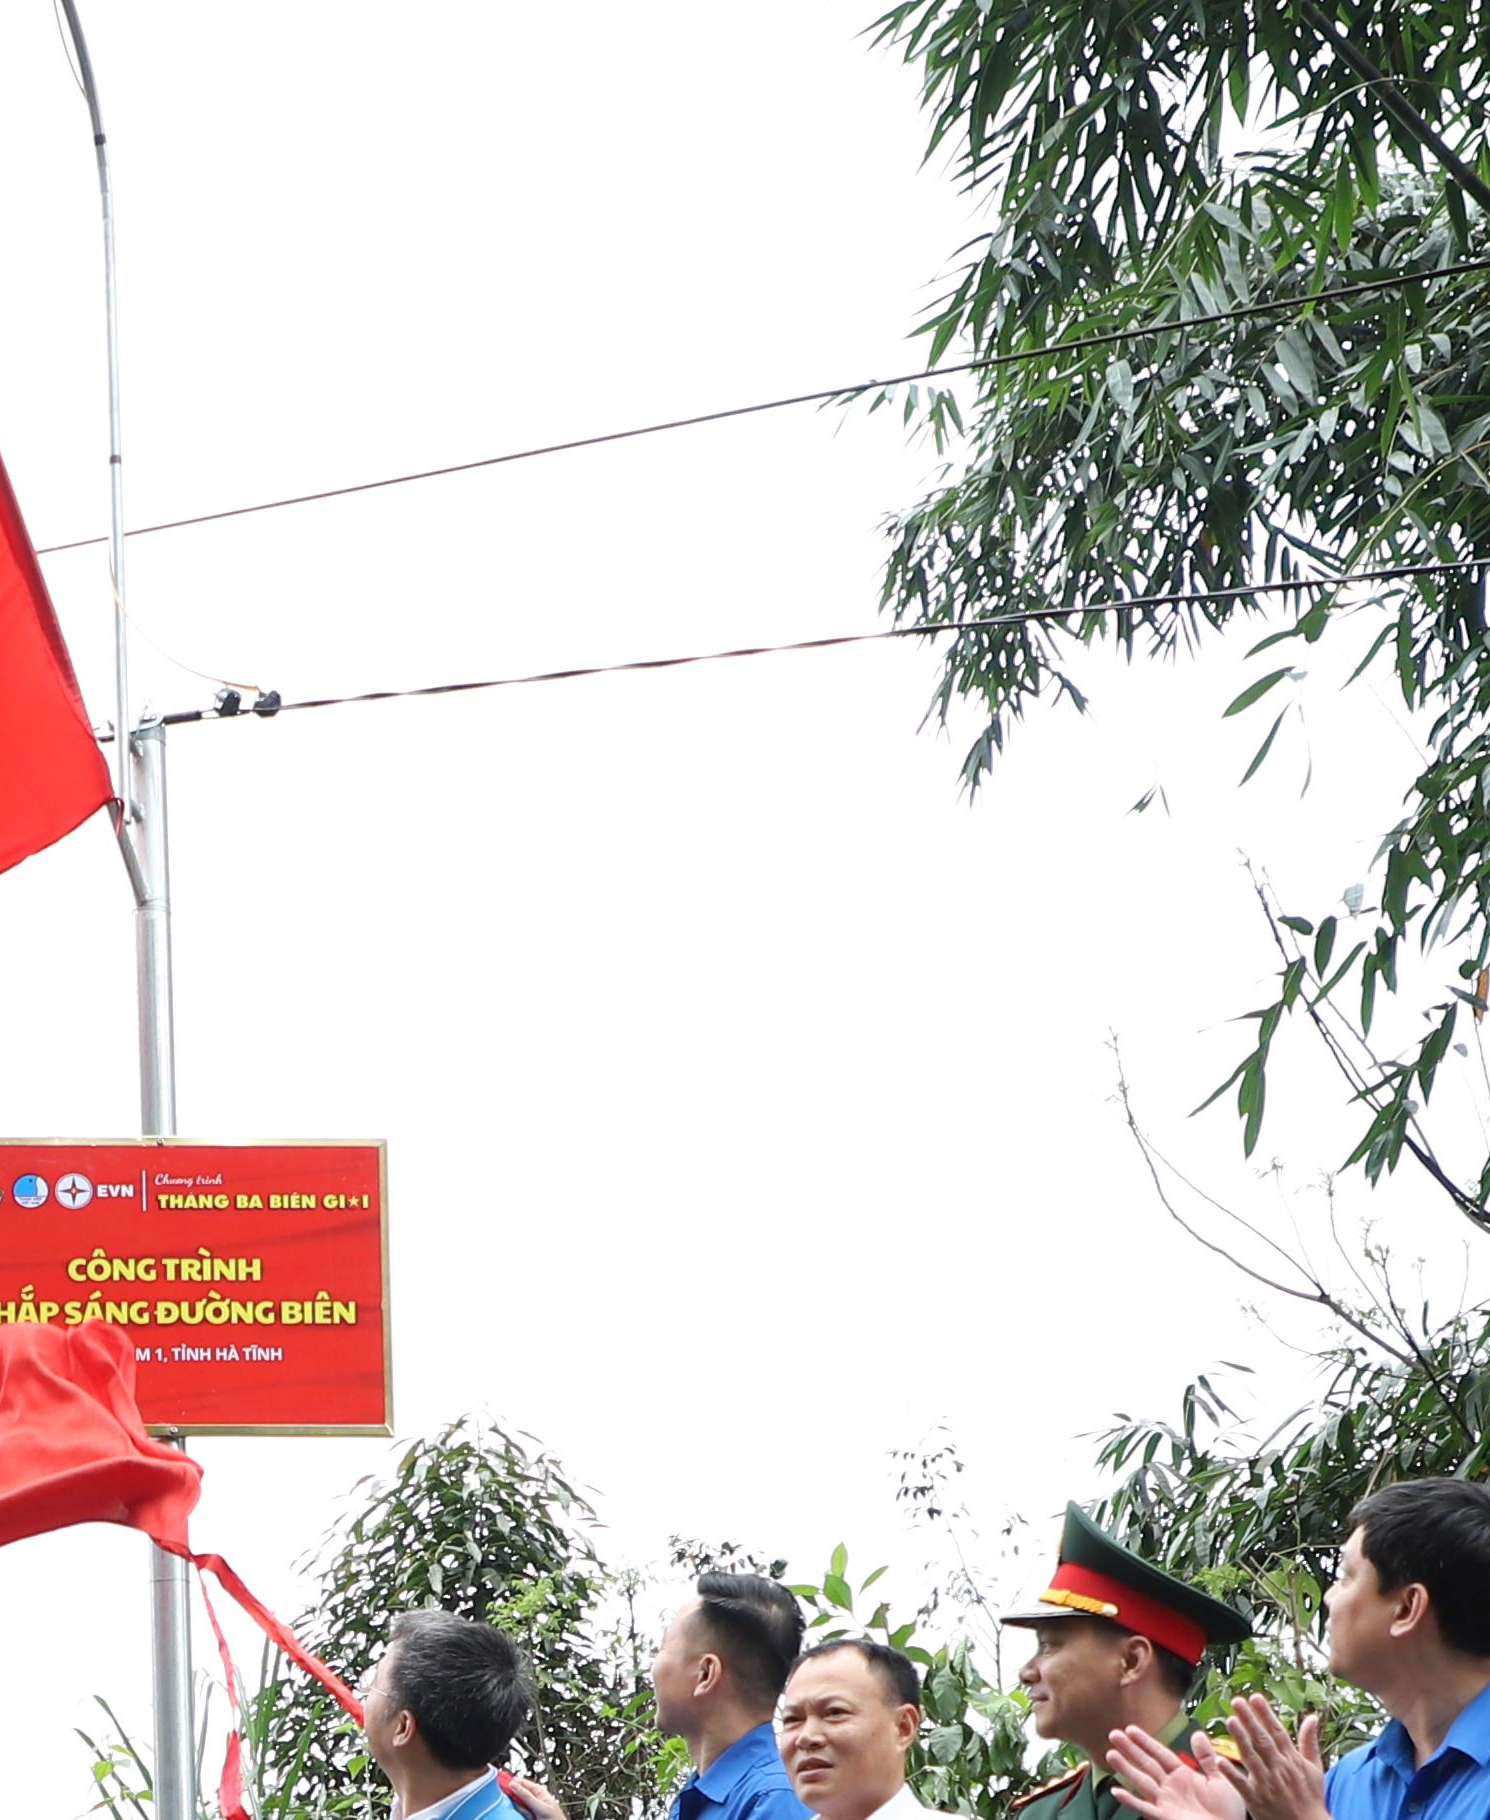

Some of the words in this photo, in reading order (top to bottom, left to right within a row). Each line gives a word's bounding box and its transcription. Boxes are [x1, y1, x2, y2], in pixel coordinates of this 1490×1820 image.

[97, 1184, 134, 1198] EVN
[236, 1194, 264, 1209] BA
[67, 1248, 157, 1282] CÔNG
[162, 1246, 262, 1282] TRÌNH
[64, 1290, 150, 1325] SÁNG
[154, 1289, 275, 1325] ĐƯỜNG
[281, 1290, 357, 1325] BIÊN
[171, 1343, 212, 1361] TỈNH
[215, 1344, 240, 1361] HÀ
[242, 1344, 283, 1361] TĨNH
